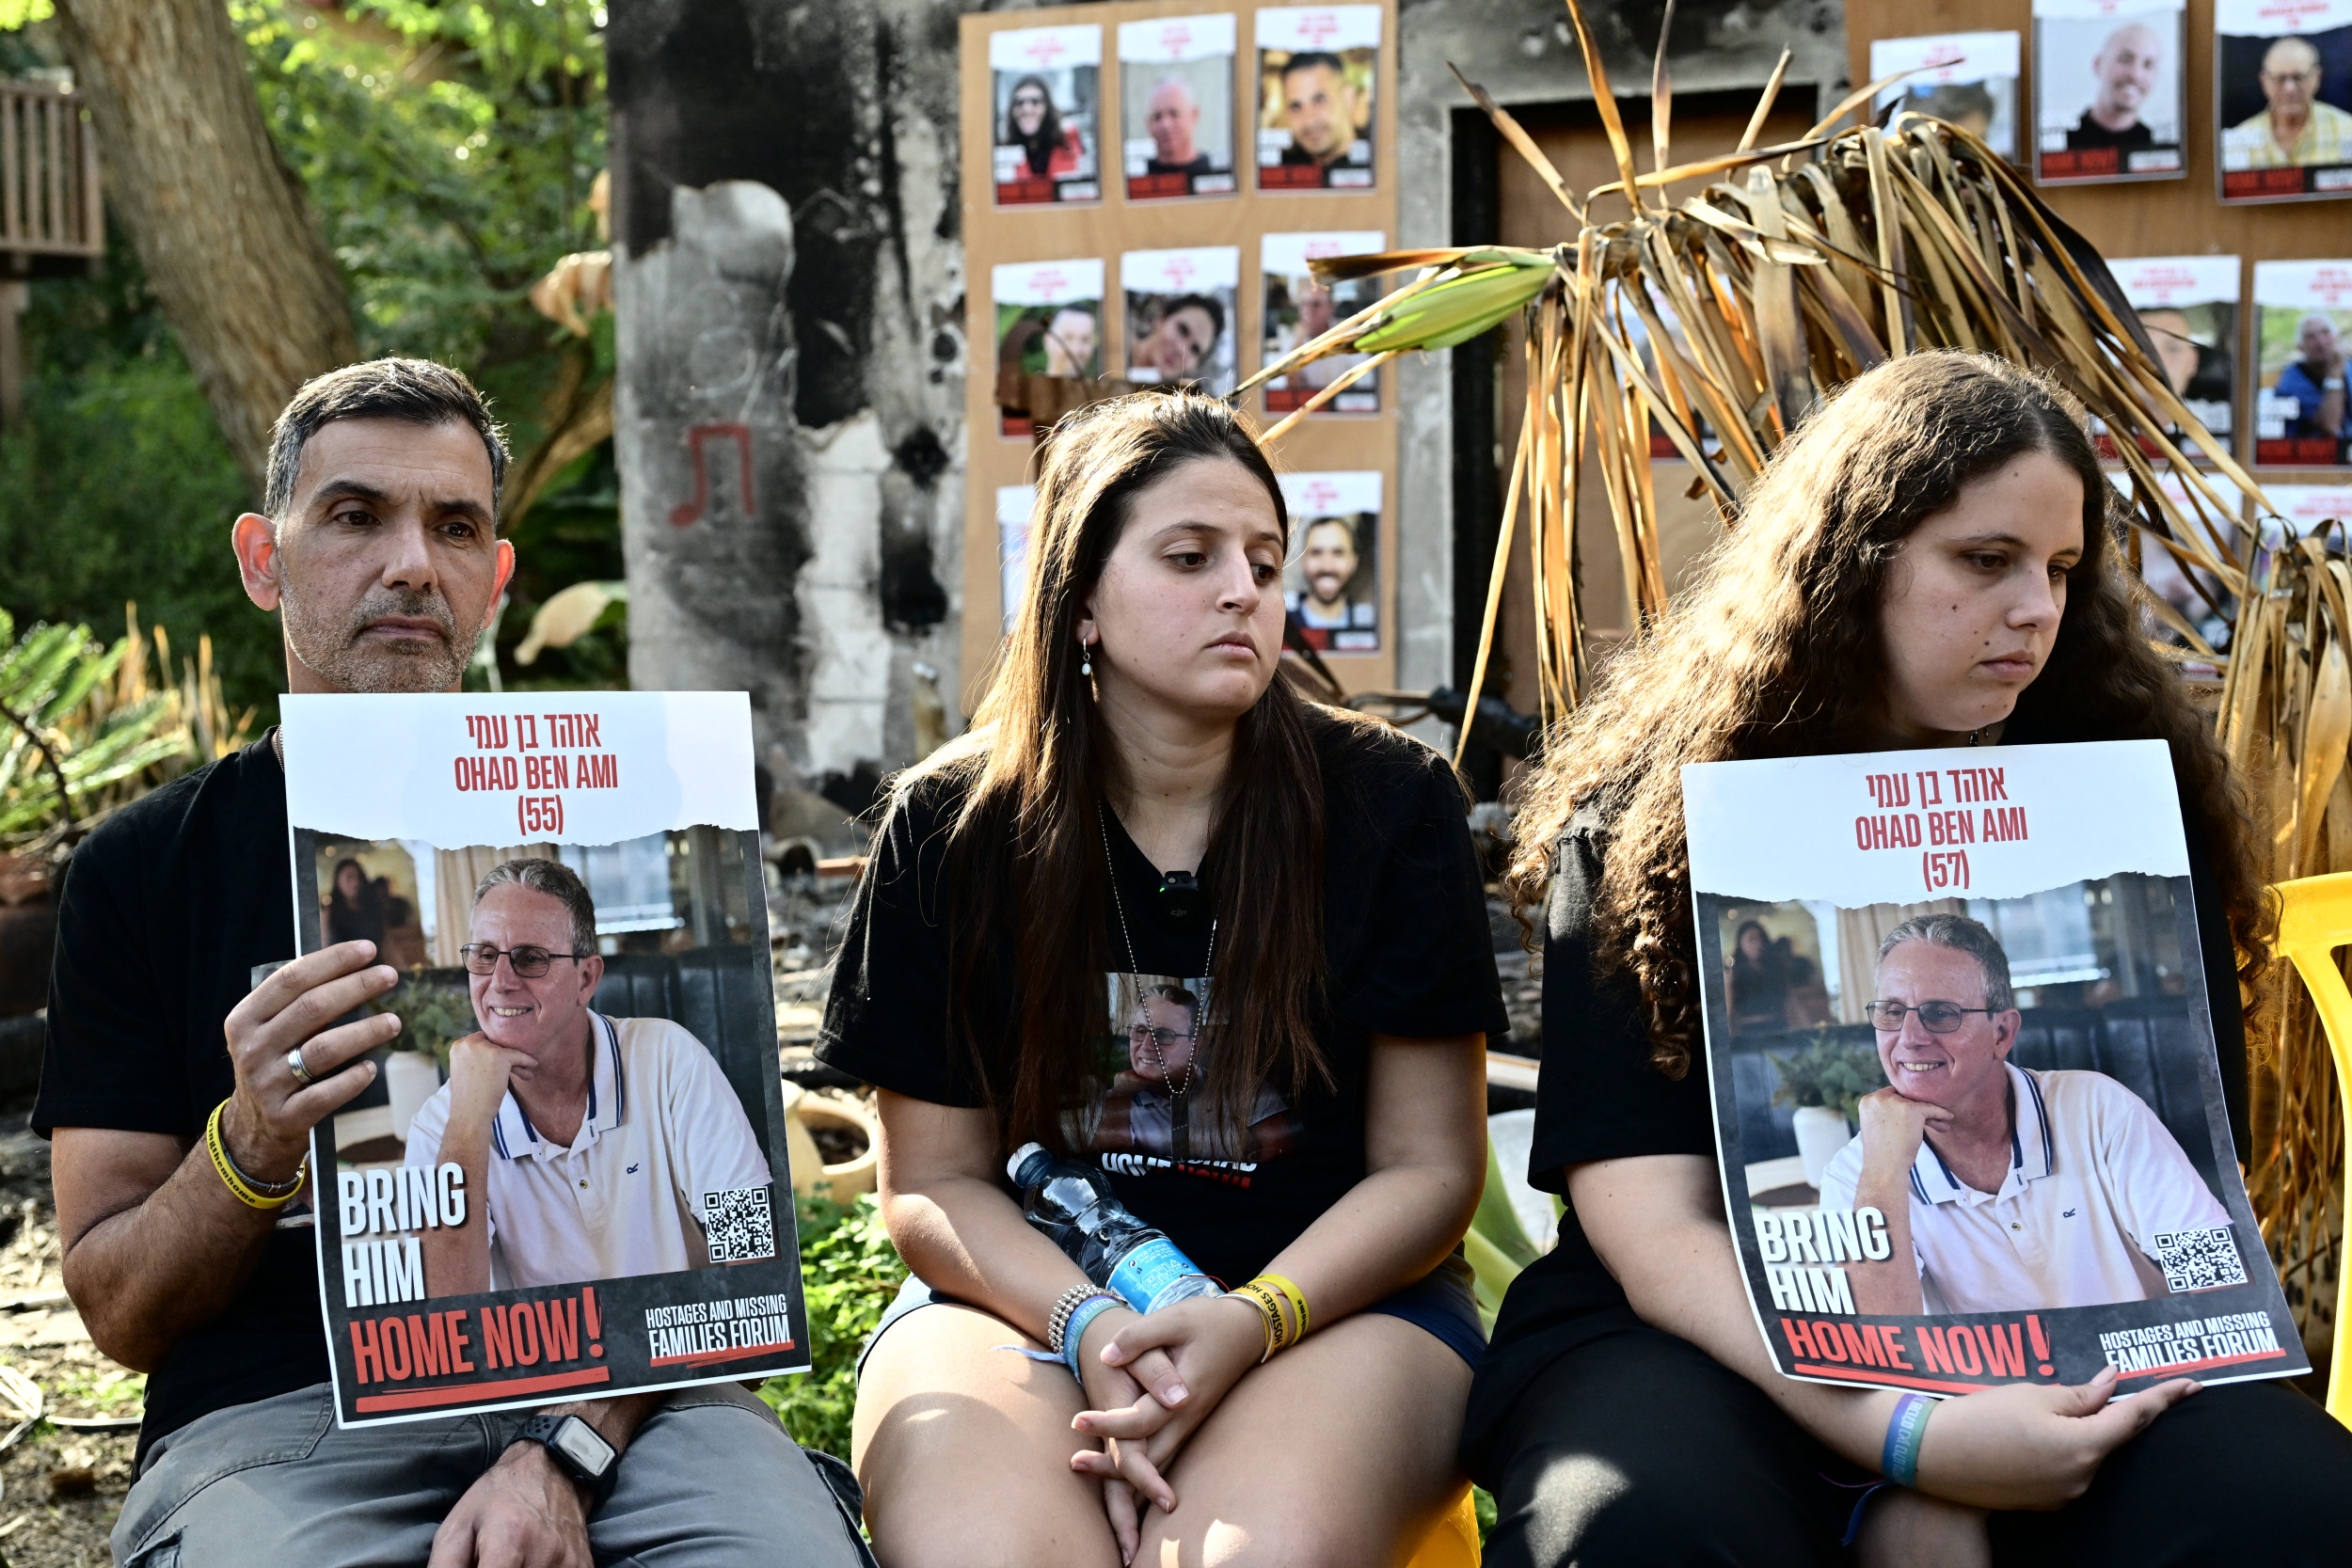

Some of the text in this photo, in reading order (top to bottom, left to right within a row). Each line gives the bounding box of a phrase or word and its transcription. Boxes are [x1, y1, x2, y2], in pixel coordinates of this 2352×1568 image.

[466, 714, 601, 752] אוהד בן עמי
[454, 754, 617, 792] OHAD BEN AMI
[1866, 768, 2008, 809] אוהד בן עמי
[517, 794, 564, 835] (55)
[1855, 807, 2028, 850] OHAD BEN AMI
[1922, 850, 1970, 892] (57)
[338, 1163, 465, 1236] BRING
[1754, 1206, 1890, 1264] BRING
[342, 1238, 425, 1307] HIM
[1763, 1266, 1854, 1315] HIM
[645, 1294, 787, 1329] HOSTAGES AND MISSING
[1261, 1292, 1282, 1344] HOSTAGES
[2099, 1311, 2271, 1351] HOSTAGES AND MISSING
[350, 1287, 604, 1385] HOME NOW!
[649, 1315, 790, 1359] FAMILIES FORUM
[1781, 1315, 2055, 1377] HOME NOW!
[2106, 1328, 2280, 1373] FAMILIES FORUM
